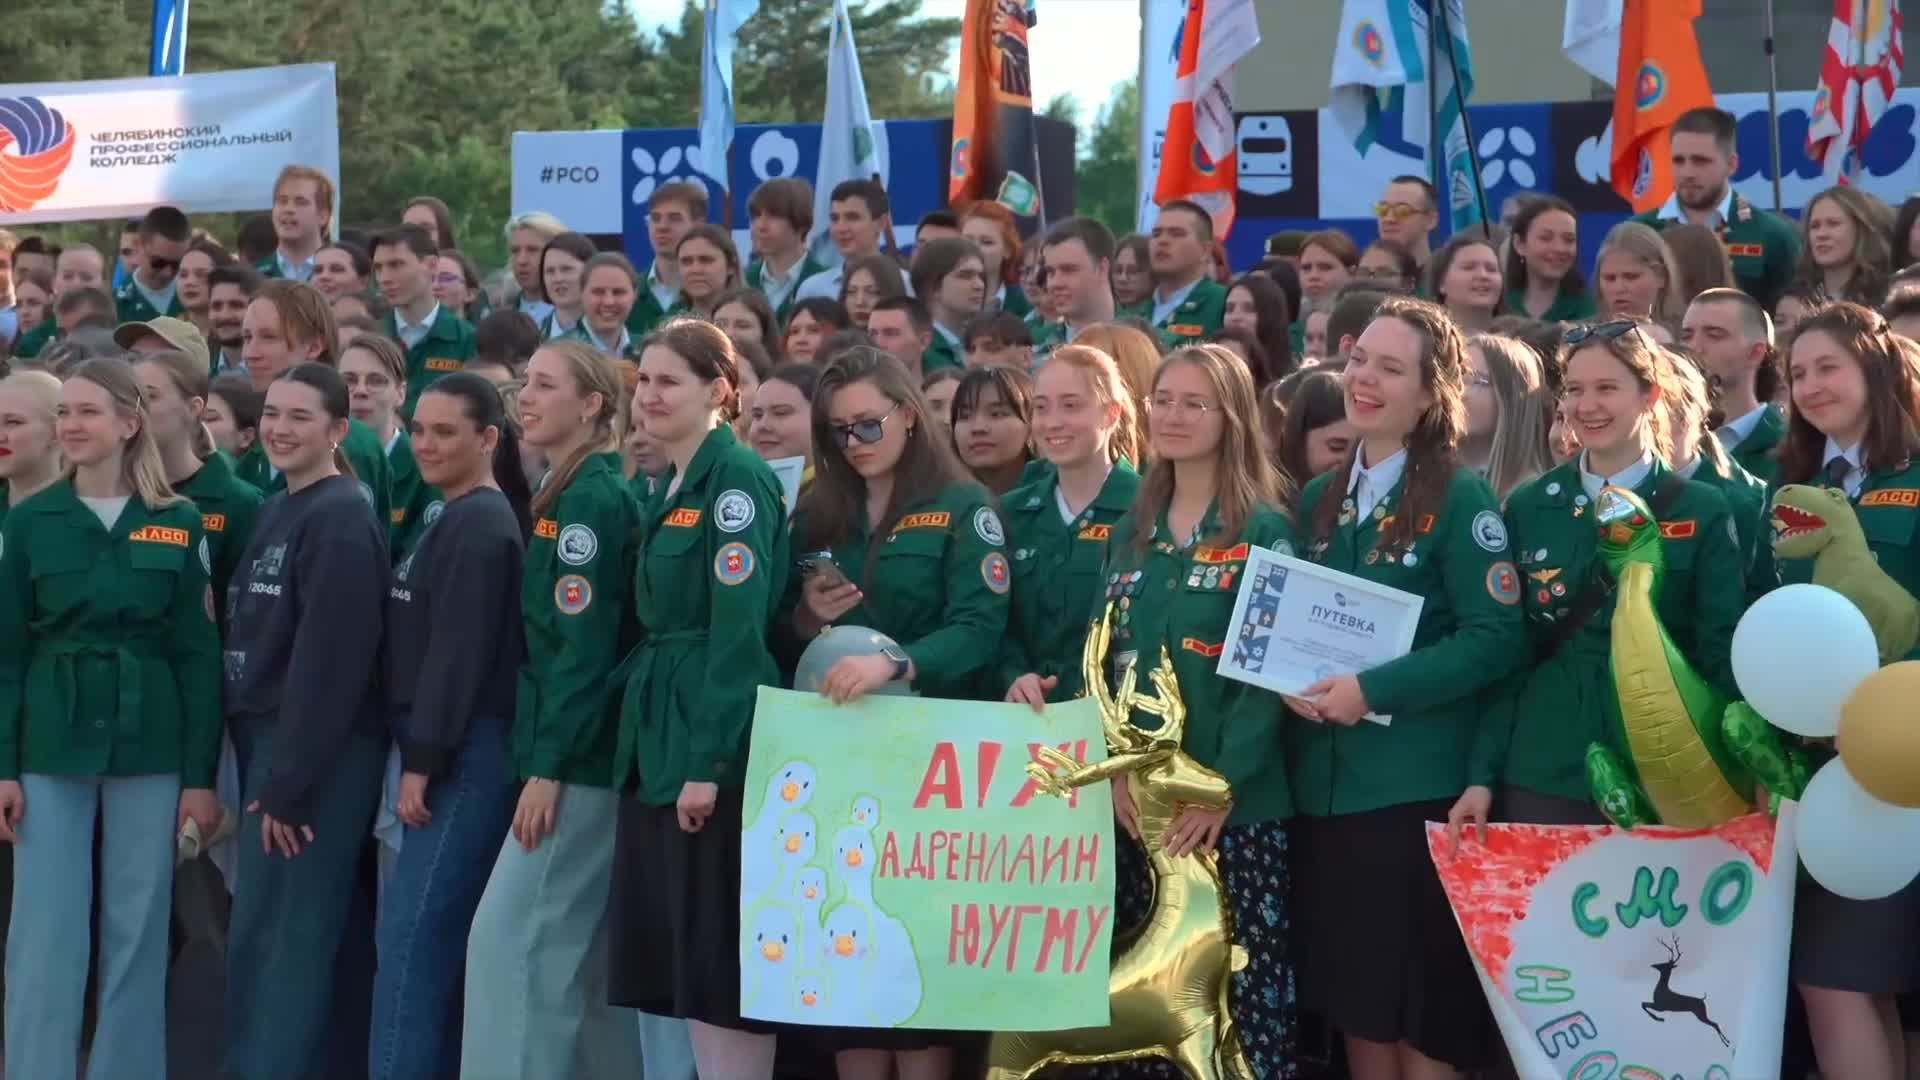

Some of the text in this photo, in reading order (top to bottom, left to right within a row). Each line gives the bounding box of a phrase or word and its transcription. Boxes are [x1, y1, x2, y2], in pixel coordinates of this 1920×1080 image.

[90, 124, 221, 143] ЧЕЛЯБИНСКИЙ
[90, 130, 293, 156] ПРОФЕССИОНАЛЬНЫЙ
[90, 153, 177, 168] КОЛЛЕДЖ
[541, 165, 600, 183] #РСО
[1311, 604, 1375, 634] ПУТЕВКА
[1571, 860, 1753, 938] СМО
[948, 903, 1112, 975] ЮУГМУ
